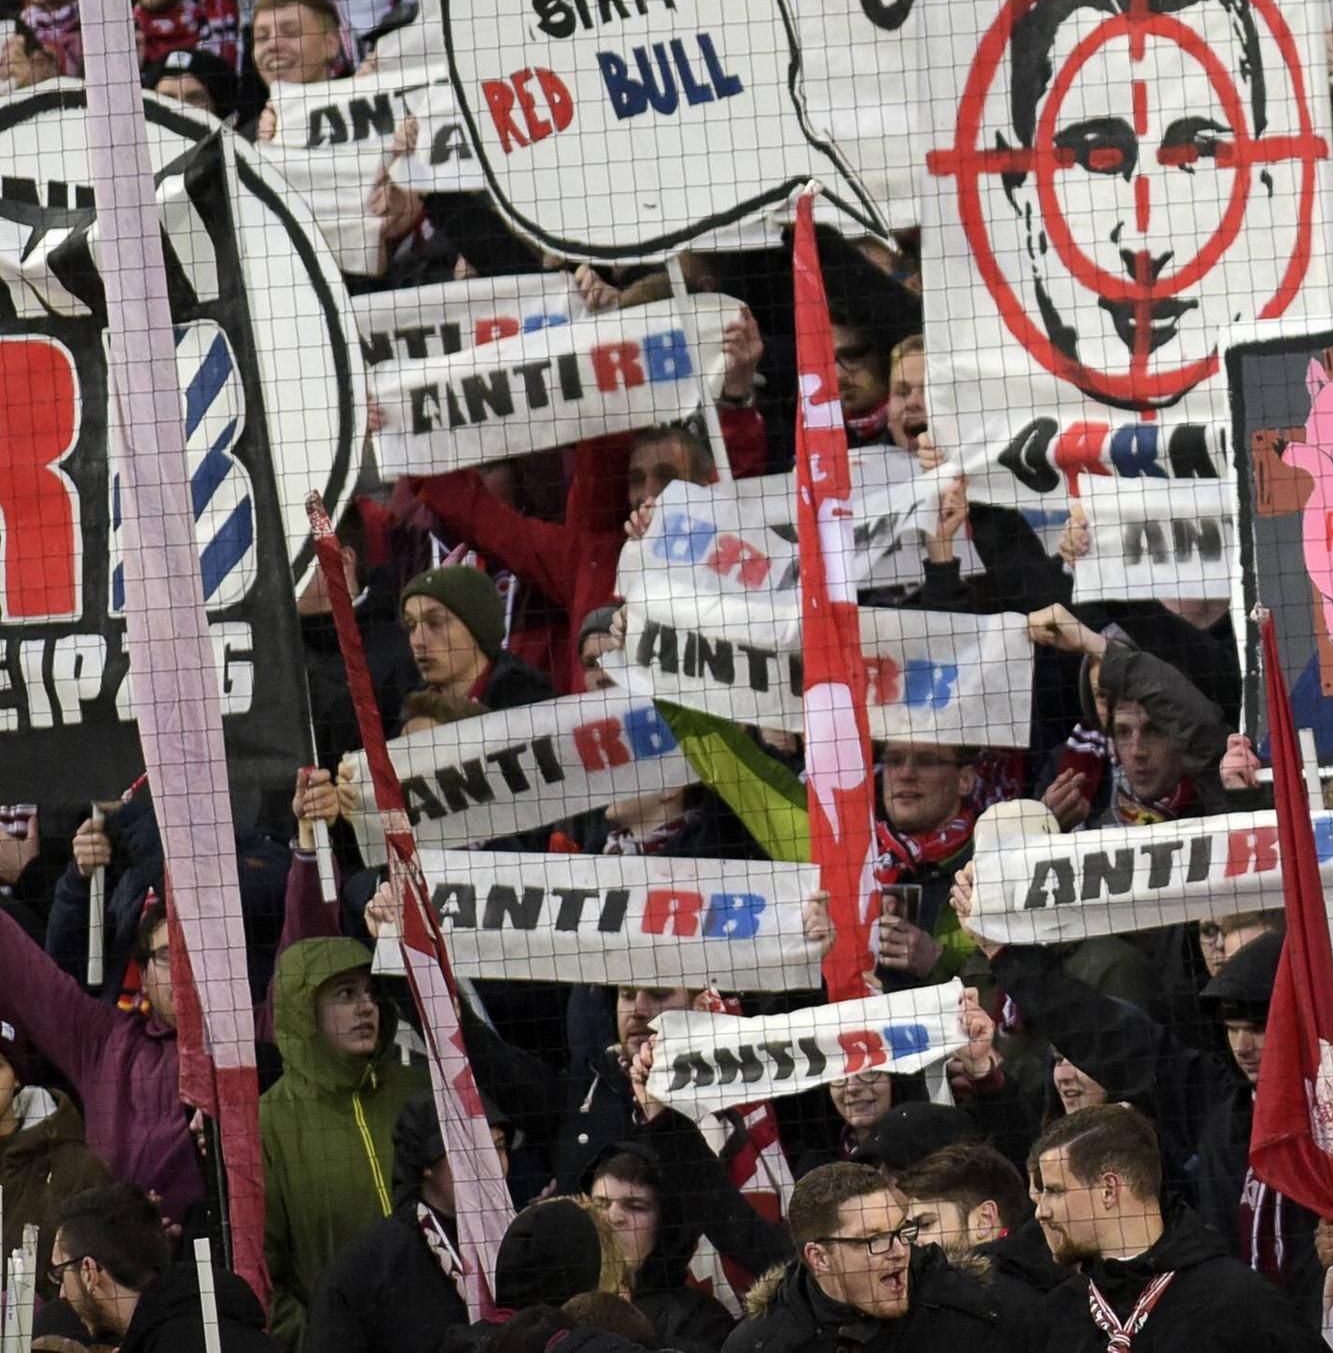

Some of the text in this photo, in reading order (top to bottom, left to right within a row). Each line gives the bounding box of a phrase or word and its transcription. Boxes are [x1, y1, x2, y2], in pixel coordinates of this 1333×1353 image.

[308, 90, 422, 148] ANT
[481, 65, 575, 154] RED
[595, 32, 746, 121] BULL
[410, 328, 694, 435] ANTI RB
[408, 705, 679, 828] ANTI RB
[1023, 834, 1213, 910] ANTI
[432, 883, 768, 940] ANTI RB
[668, 1023, 931, 1093] ANTI RB
